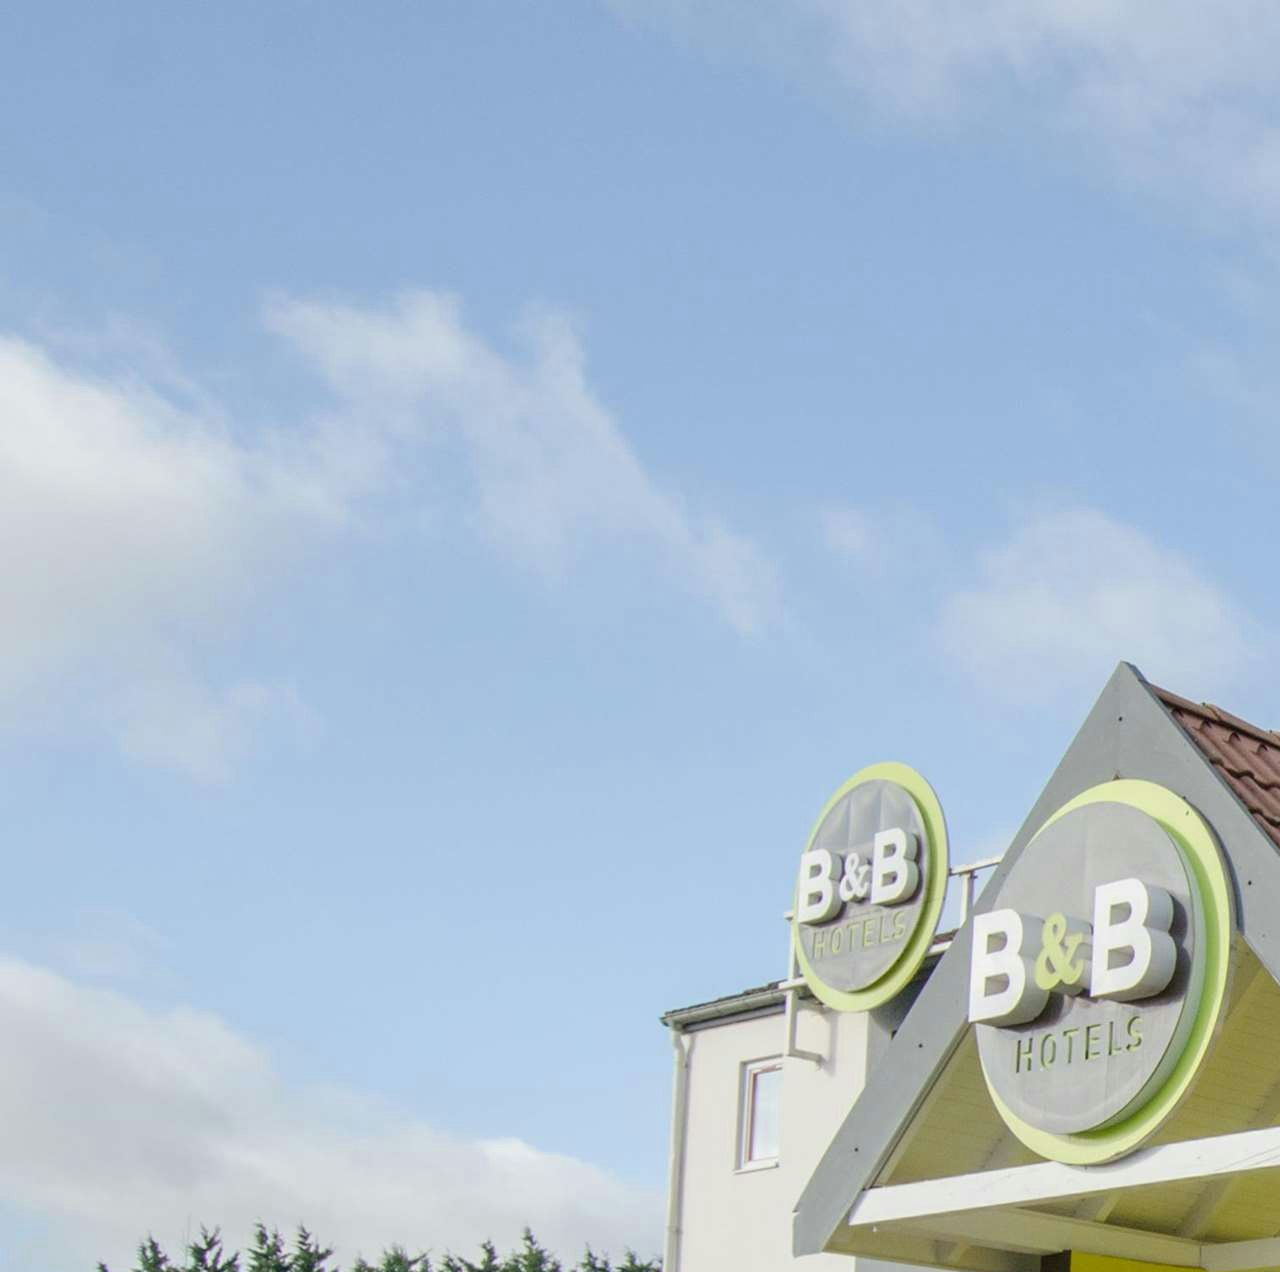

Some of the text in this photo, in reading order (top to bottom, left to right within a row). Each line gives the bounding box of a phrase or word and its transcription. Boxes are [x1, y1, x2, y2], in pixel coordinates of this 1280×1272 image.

[798, 827, 917, 925] B&B
[812, 911, 906, 959] HOTELS
[968, 878, 1176, 1027] B&B
[1014, 1016, 1144, 1073] HOTELS
